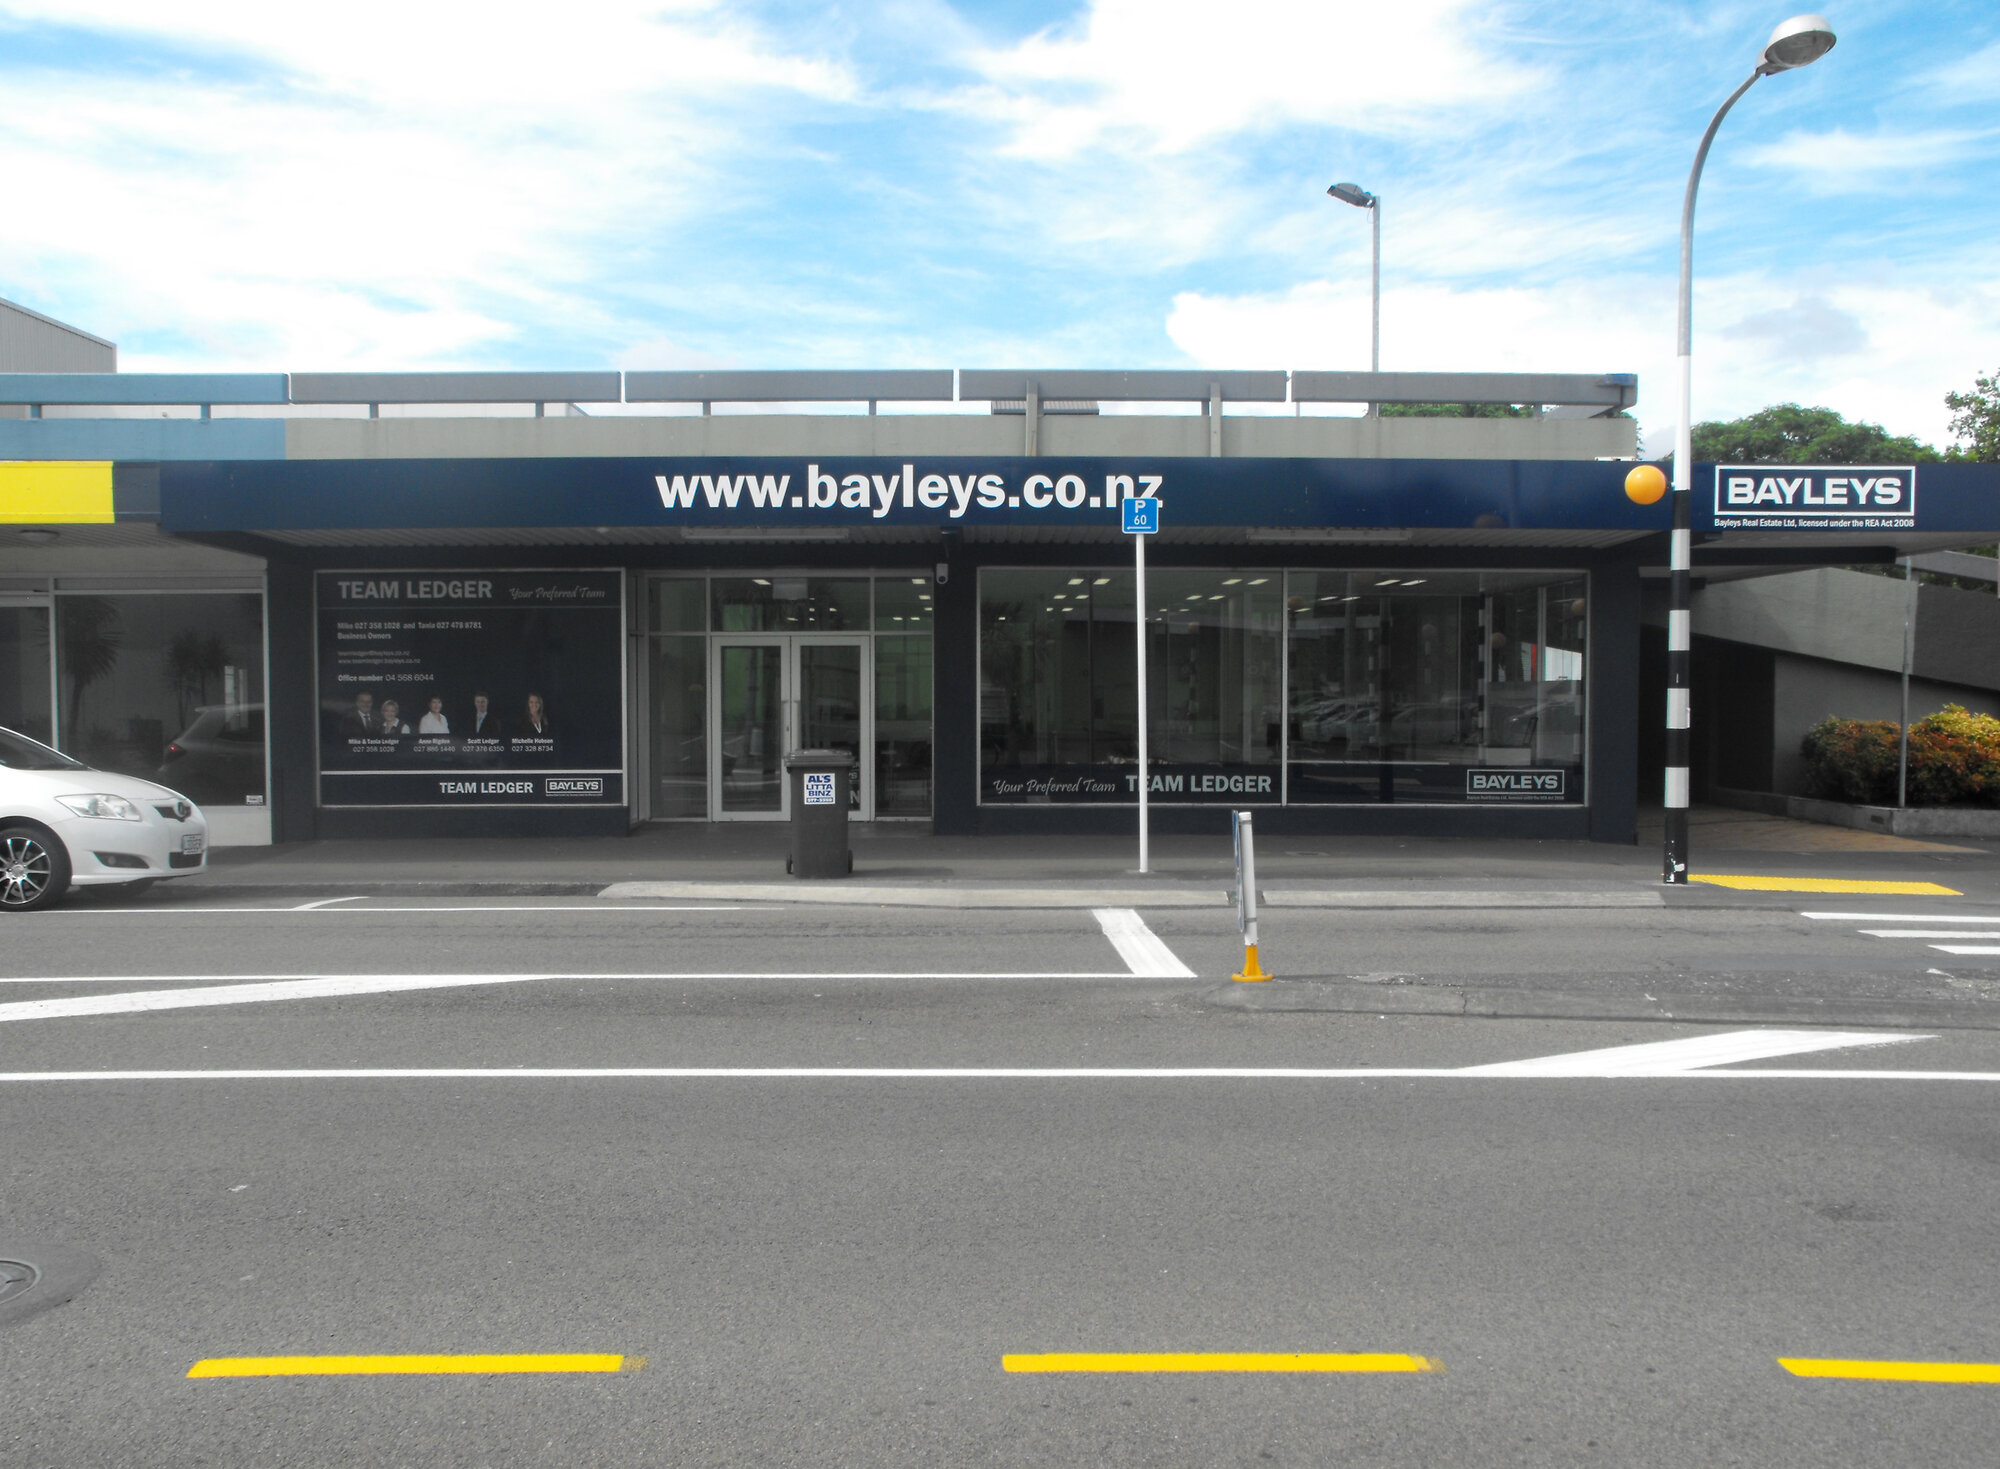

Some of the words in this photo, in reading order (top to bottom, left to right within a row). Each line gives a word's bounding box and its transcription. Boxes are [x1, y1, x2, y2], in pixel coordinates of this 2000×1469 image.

[656, 464, 1163, 518] www.bayleys.co.nz
[1727, 477, 1902, 505] BAYLEYS
[1135, 500, 1146, 513] P
[1134, 514, 1147, 525] 60
[1714, 518, 1741, 528] Bayleys
[1742, 519, 1758, 527] Real
[1759, 519, 1782, 527] Estate
[1783, 519, 1797, 528] Ltd,
[1798, 519, 1828, 527] licensed
[1829, 519, 1850, 527] under
[1851, 519, 1864, 527] the
[1865, 519, 1879, 527] REA
[1880, 519, 1893, 527] Act
[1894, 519, 1914, 527] 2008
[338, 581, 399, 599] TEAM
[406, 580, 492, 599] LEDGER
[508, 586, 532, 600] Your
[534, 586, 578, 601] Preferred
[579, 587, 606, 599] Team
[354, 621, 368, 629] 027
[436, 621, 450, 629] 027
[337, 632, 366, 640] Business
[368, 632, 391, 640] Owners
[338, 674, 358, 682] Office
[482, 738, 499, 746] Ledger
[511, 737, 533, 745] Michelle
[808, 775, 831, 783] AL'S
[1126, 775, 1183, 792] TAM
[1190, 775, 1272, 792] LEDGER
[1473, 775, 1558, 789] BAYLEYS
[439, 782, 477, 793] TEAM
[481, 782, 533, 793] LEDGER
[549, 781, 599, 790] BAYLEYS
[992, 779, 1024, 794] Your
[1026, 777, 1079, 796] Preferred
[1082, 778, 1116, 792] Team
